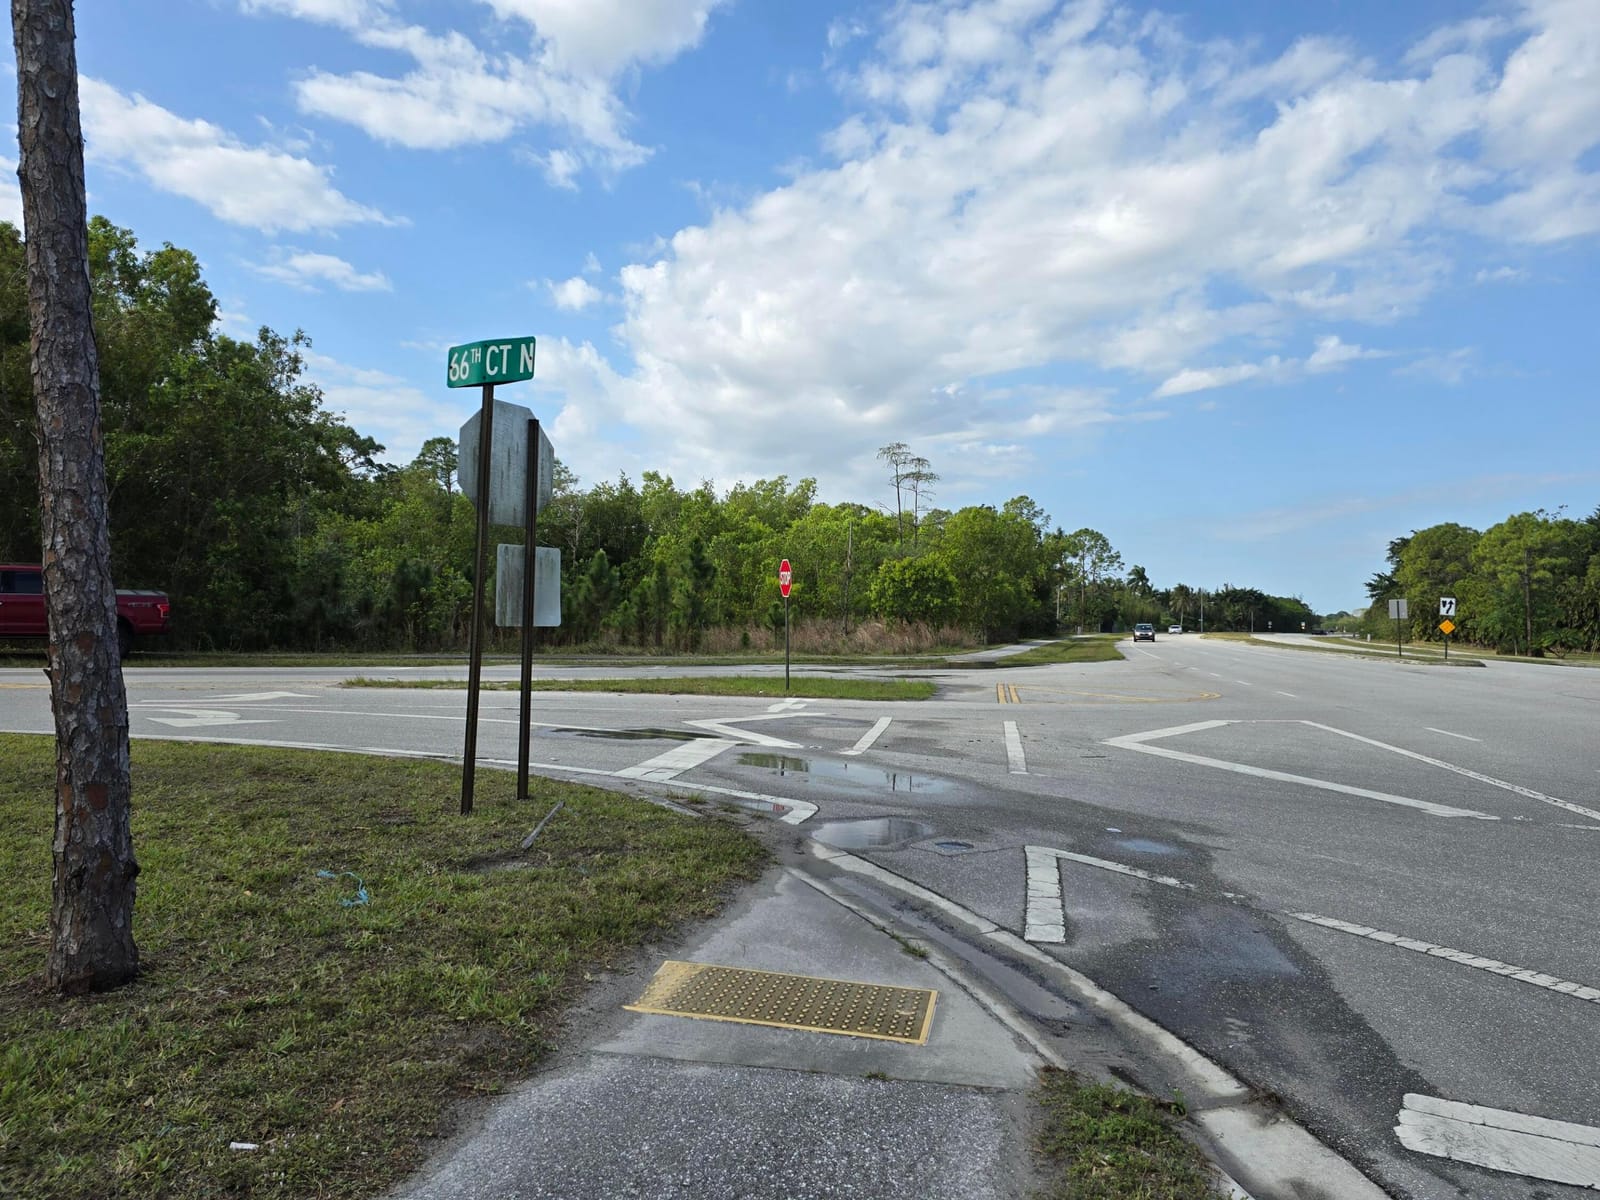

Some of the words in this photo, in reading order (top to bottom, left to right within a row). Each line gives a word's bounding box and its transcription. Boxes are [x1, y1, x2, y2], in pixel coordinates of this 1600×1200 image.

[486, 344, 512, 376] CT
[520, 342, 534, 374] N
[780, 571, 791, 586] STOP
